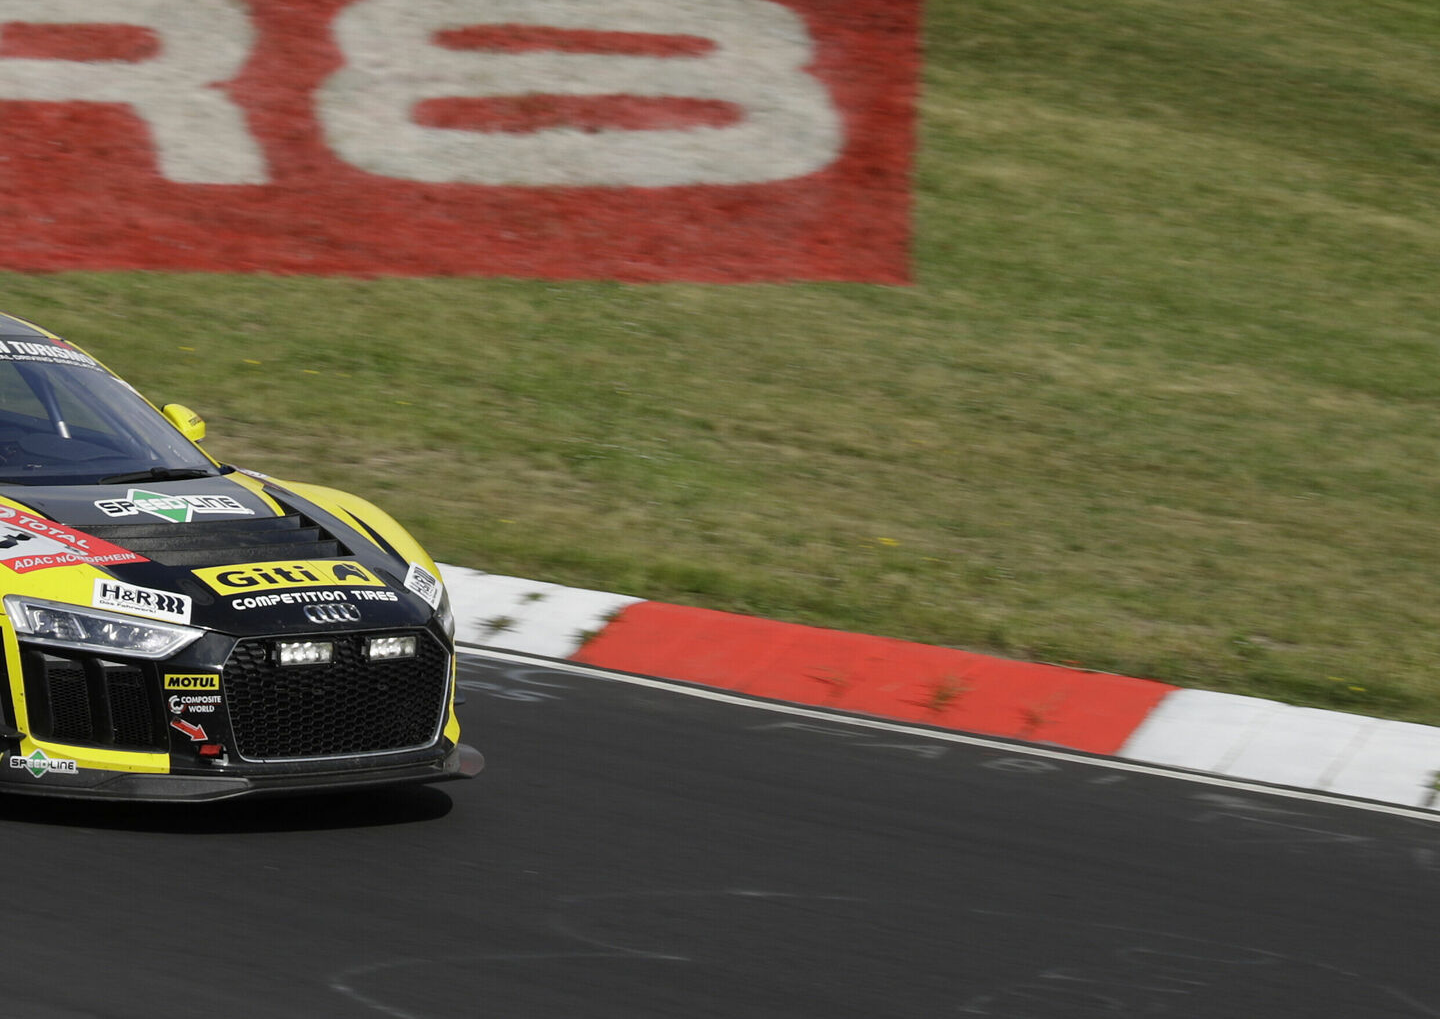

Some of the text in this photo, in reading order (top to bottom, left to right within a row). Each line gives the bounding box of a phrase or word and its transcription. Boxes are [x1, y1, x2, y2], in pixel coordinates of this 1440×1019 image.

[8, 341, 97, 367] TURISMO
[19, 515, 91, 549] TOTAL
[14, 557, 53, 570] ADAC
[216, 565, 319, 588] Giti
[101, 583, 152, 606] H&R
[232, 589, 398, 611] COMPETITION TIRES
[167, 677, 216, 688] MOTUL
[181, 695, 222, 704] COMPOSITE
[188, 705, 215, 713] WORLD
